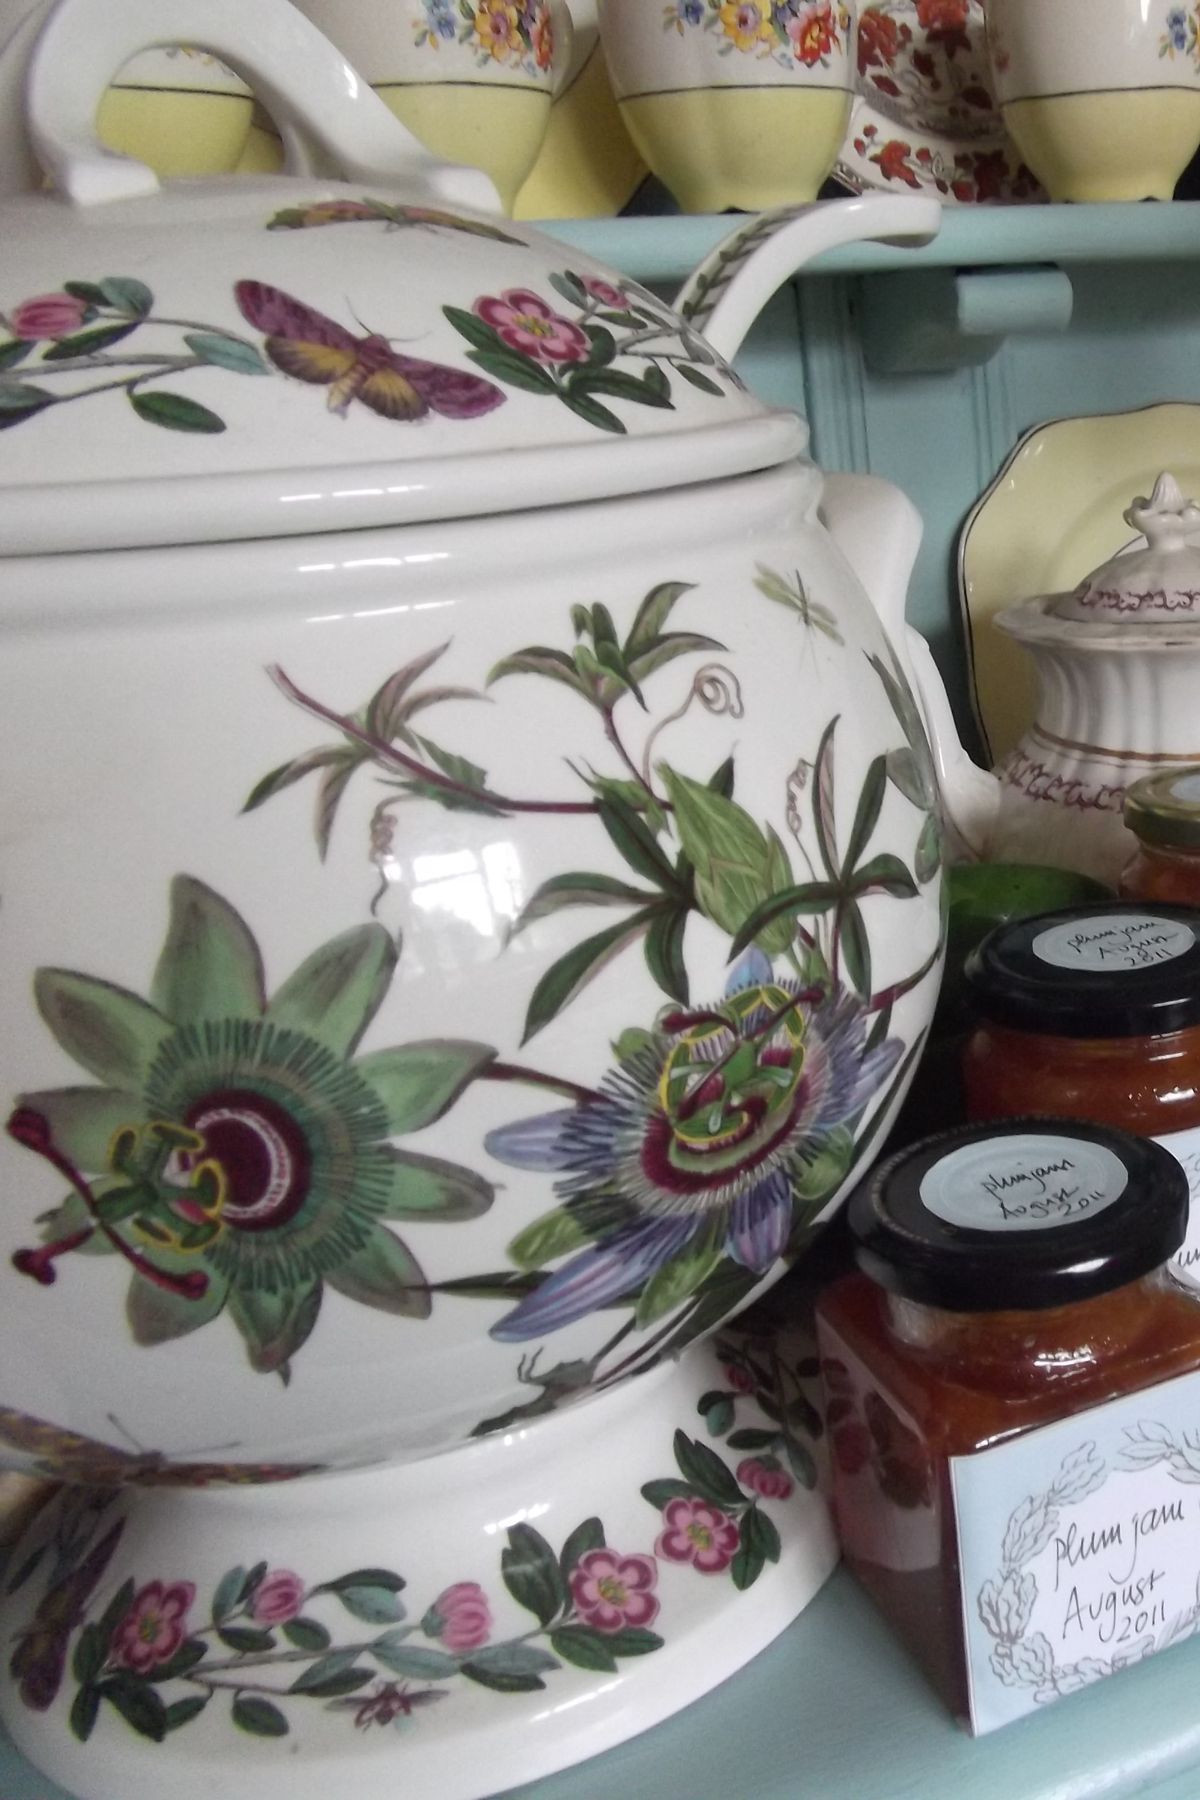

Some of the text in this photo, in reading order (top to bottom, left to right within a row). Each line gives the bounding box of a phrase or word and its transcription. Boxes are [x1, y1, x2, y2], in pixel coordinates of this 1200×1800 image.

[1067, 921, 1163, 954] plum jam
[1098, 932, 1179, 960] August
[1123, 949, 1173, 967] 2011
[980, 1158, 1076, 1200] plum jam
[999, 1186, 1080, 1220] August
[1057, 1189, 1106, 1217] 2011
[1055, 1499, 1185, 1592] plum jam
[1062, 1569, 1166, 1643] August
[1116, 1602, 1166, 1643] 2011
